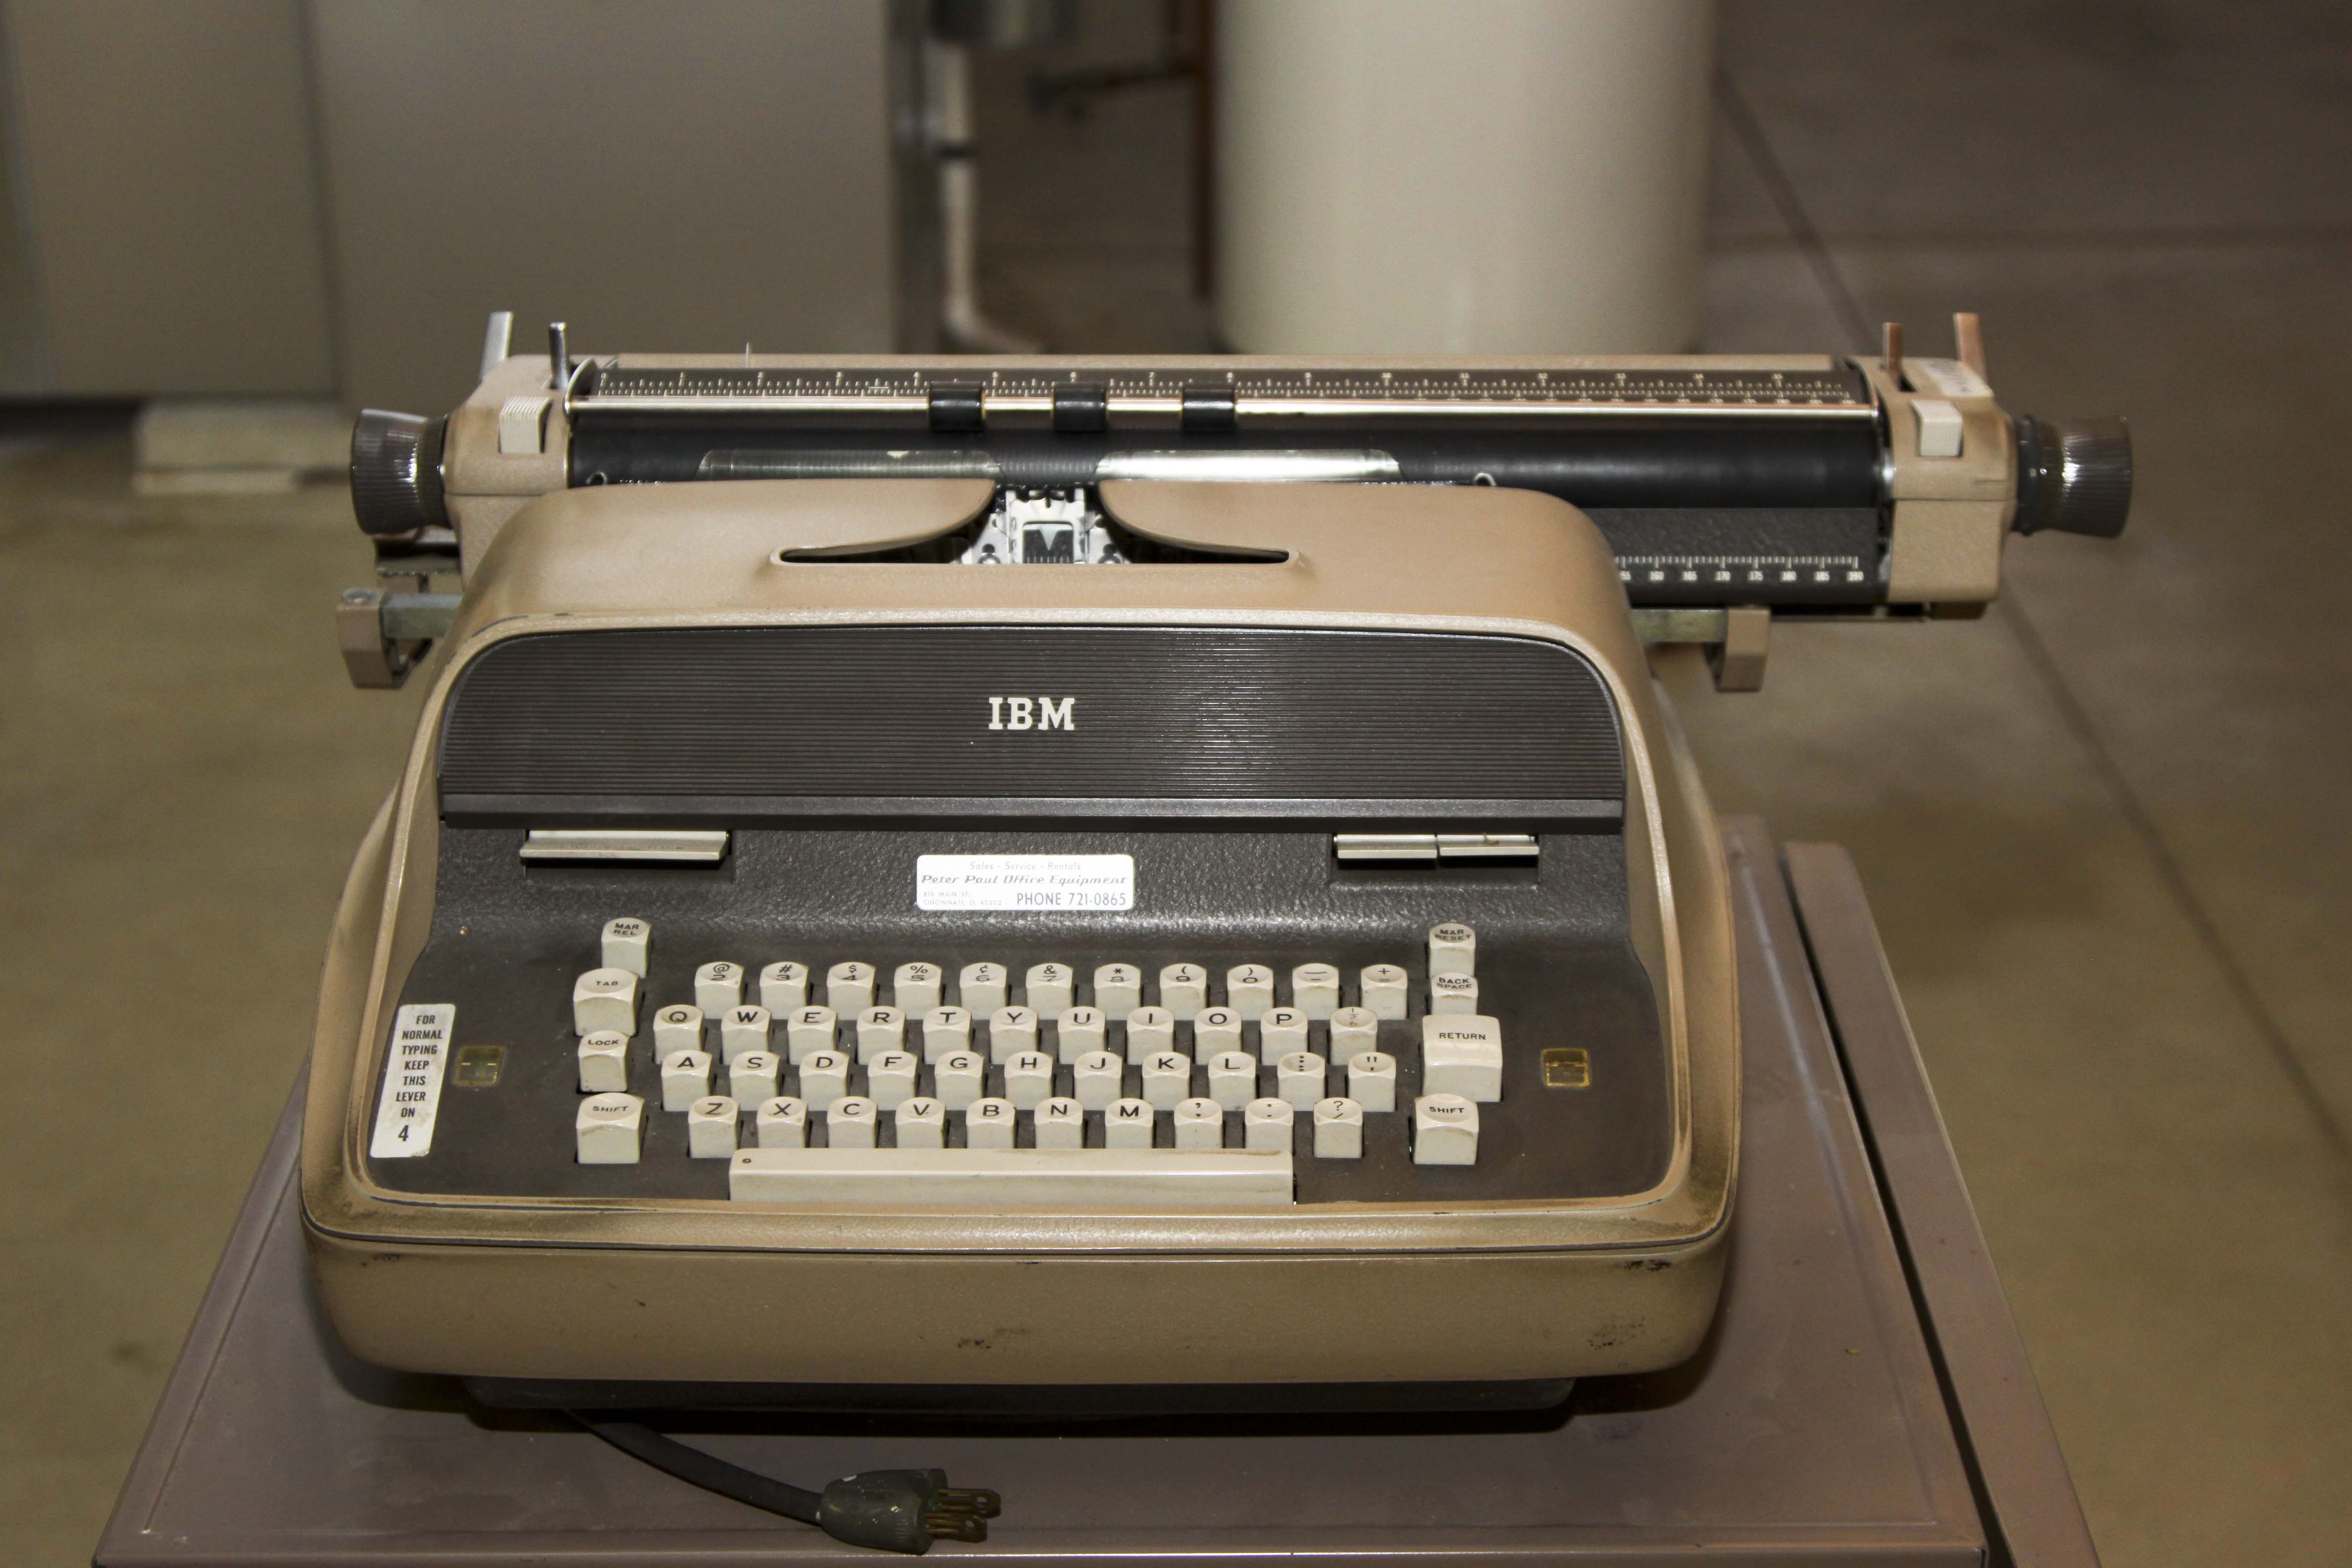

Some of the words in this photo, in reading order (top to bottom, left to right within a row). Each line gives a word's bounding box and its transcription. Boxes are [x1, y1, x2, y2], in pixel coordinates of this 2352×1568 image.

[1617, 571, 1631, 580] 55
[1715, 571, 1730, 580] 170
[1748, 571, 1763, 580] 175
[1814, 571, 1830, 580] 185
[989, 697, 1075, 730] IBM
[970, 861, 993, 870] Sales
[1005, 861, 1036, 870] Service
[1047, 862, 1080, 870] Rentals
[921, 875, 959, 883] Peter
[965, 875, 999, 883] Paul
[1003, 875, 1044, 883] Office
[1049, 875, 1128, 886] Equipment
[1017, 892, 1061, 906] PHONE
[1069, 892, 1126, 906] 721-0865
[848, 965, 857, 973] $
[910, 965, 928, 974] %
[1044, 966, 1057, 975] &
[416, 1015, 436, 1025] FOR
[669, 1012, 687, 1022] Q
[737, 1012, 757, 1022] W
[804, 1013, 821, 1023] E
[873, 1013, 889, 1023] R
[940, 1013, 956, 1023] T
[1007, 1013, 1022, 1023] Y
[1074, 1013, 1090, 1024] U
[1209, 1014, 1227, 1024] O
[1276, 1014, 1292, 1024] P
[402, 1029, 443, 1040] NORMAL
[402, 1045, 437, 1055] TYPING
[404, 1061, 429, 1071] KEEP
[678, 1057, 694, 1068] A
[747, 1058, 762, 1068] S
[816, 1057, 833, 1068] D
[884, 1057, 901, 1067] F
[950, 1058, 968, 1068] G
[1021, 1058, 1036, 1068] H
[1090, 1058, 1105, 1069] J
[1159, 1058, 1174, 1069] K
[1225, 1059, 1240, 1069] L
[403, 1076, 426, 1086] THIS
[396, 1092, 426, 1102] LEVER
[400, 1108, 415, 1118] ON
[705, 1103, 723, 1115] Z
[773, 1104, 791, 1115] X
[843, 1104, 860, 1115] C
[914, 1104, 929, 1116] V
[983, 1105, 999, 1116] B
[1051, 1105, 1067, 1115] N
[1120, 1106, 1138, 1117] M
[398, 1125, 409, 1141] 4
